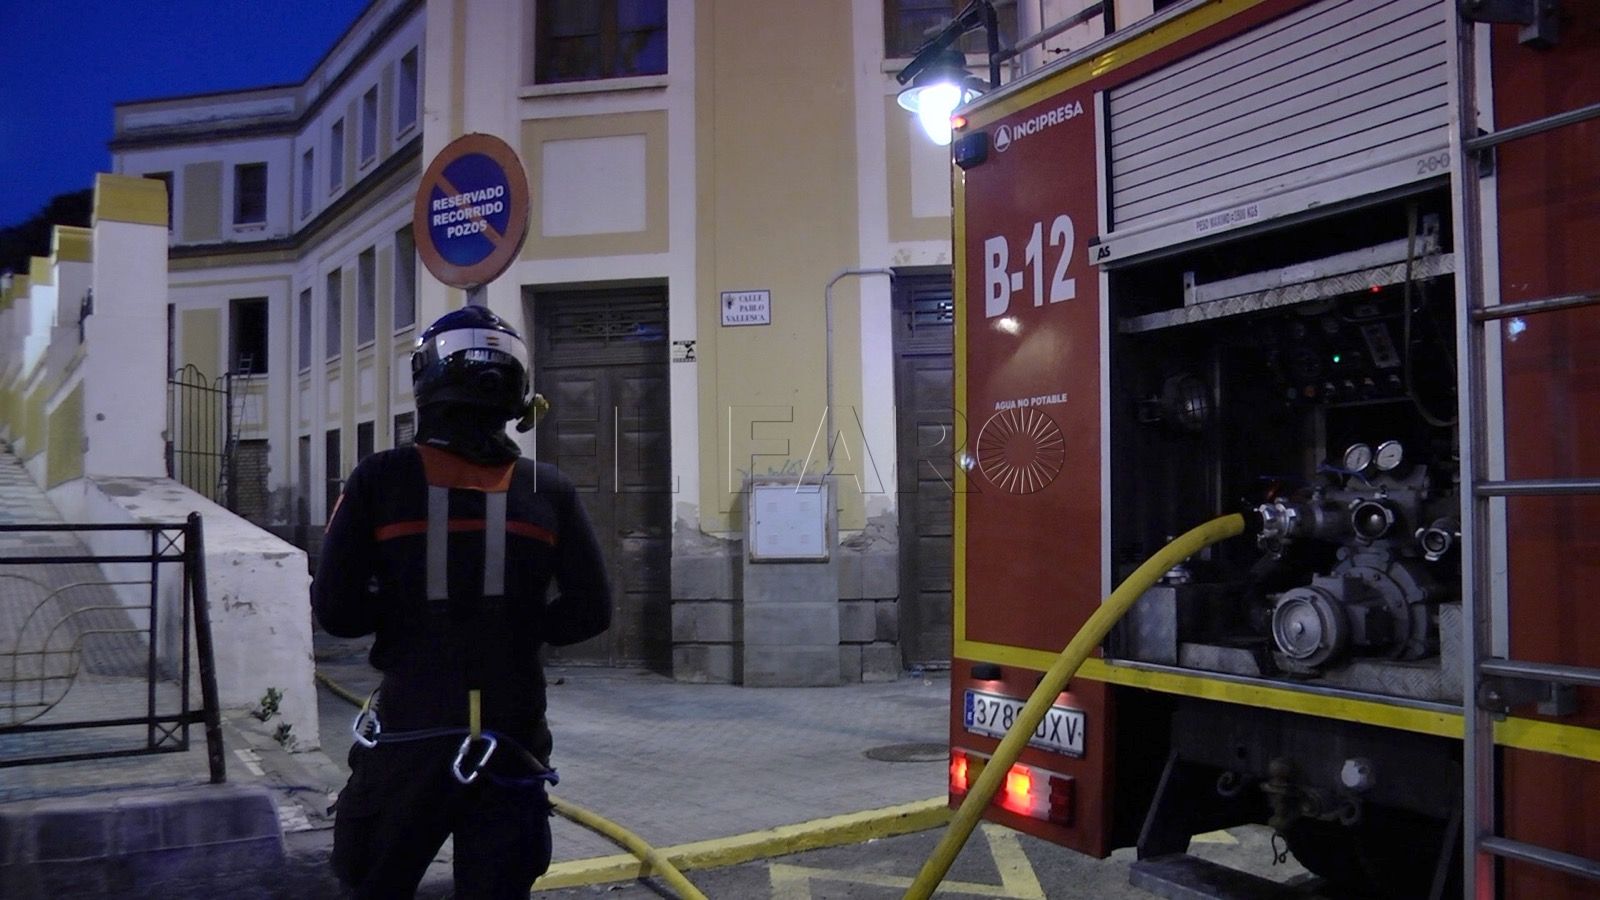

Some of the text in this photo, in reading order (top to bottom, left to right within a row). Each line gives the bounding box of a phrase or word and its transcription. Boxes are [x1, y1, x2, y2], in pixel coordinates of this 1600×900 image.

[1013, 101, 1084, 140] INCIPRESA
[433, 185, 504, 211] RESERVADO
[433, 201, 504, 226] RECORRIDO
[447, 220, 487, 238] POZOS
[984, 214, 1076, 318] B-12
[738, 294, 763, 302] CALLE
[739, 304, 765, 313] PABLO
[994, 393, 1068, 411] AGUA NO POTABLE
[976, 699, 1024, 731] 378
